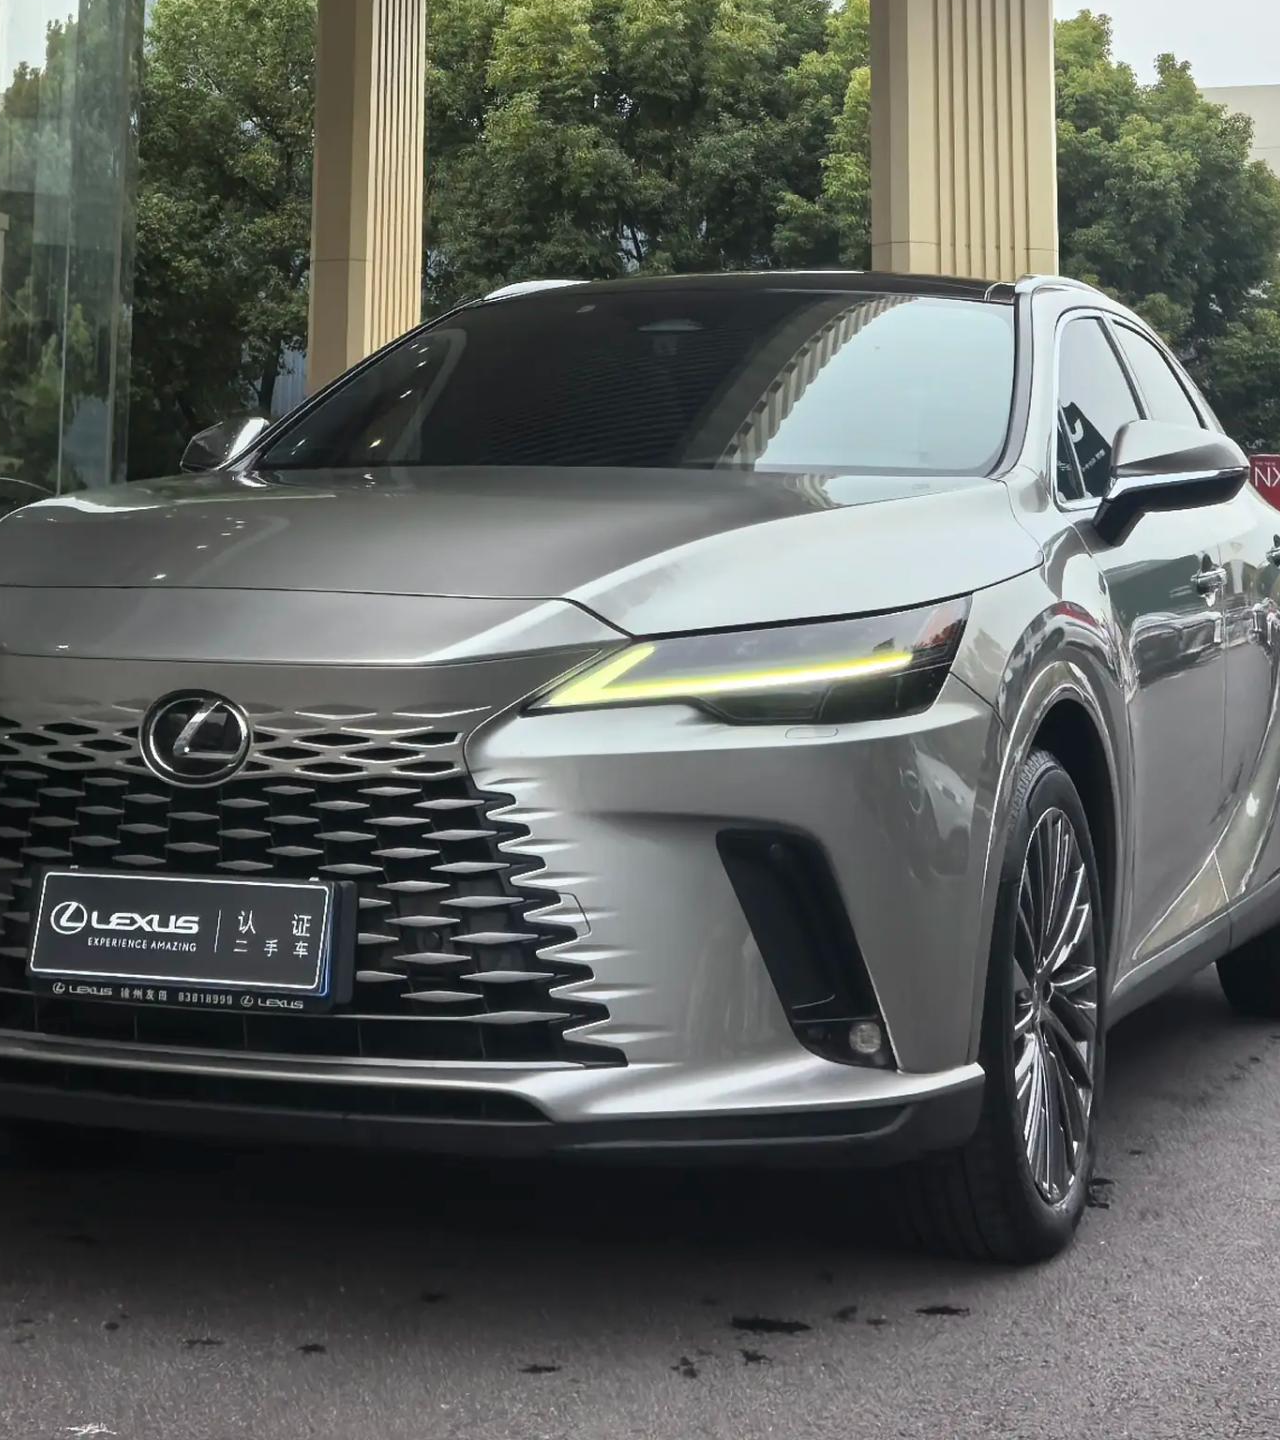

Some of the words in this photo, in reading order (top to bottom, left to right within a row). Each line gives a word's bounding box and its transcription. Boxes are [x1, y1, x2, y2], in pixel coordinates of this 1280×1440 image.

[91, 911, 200, 935] LEXUS
[87, 937, 148, 950] EXPERIENCE
[150, 939, 197, 953] AMAZING
[69, 985, 113, 997] LEXUS
[257, 998, 304, 1010] LEXUS
